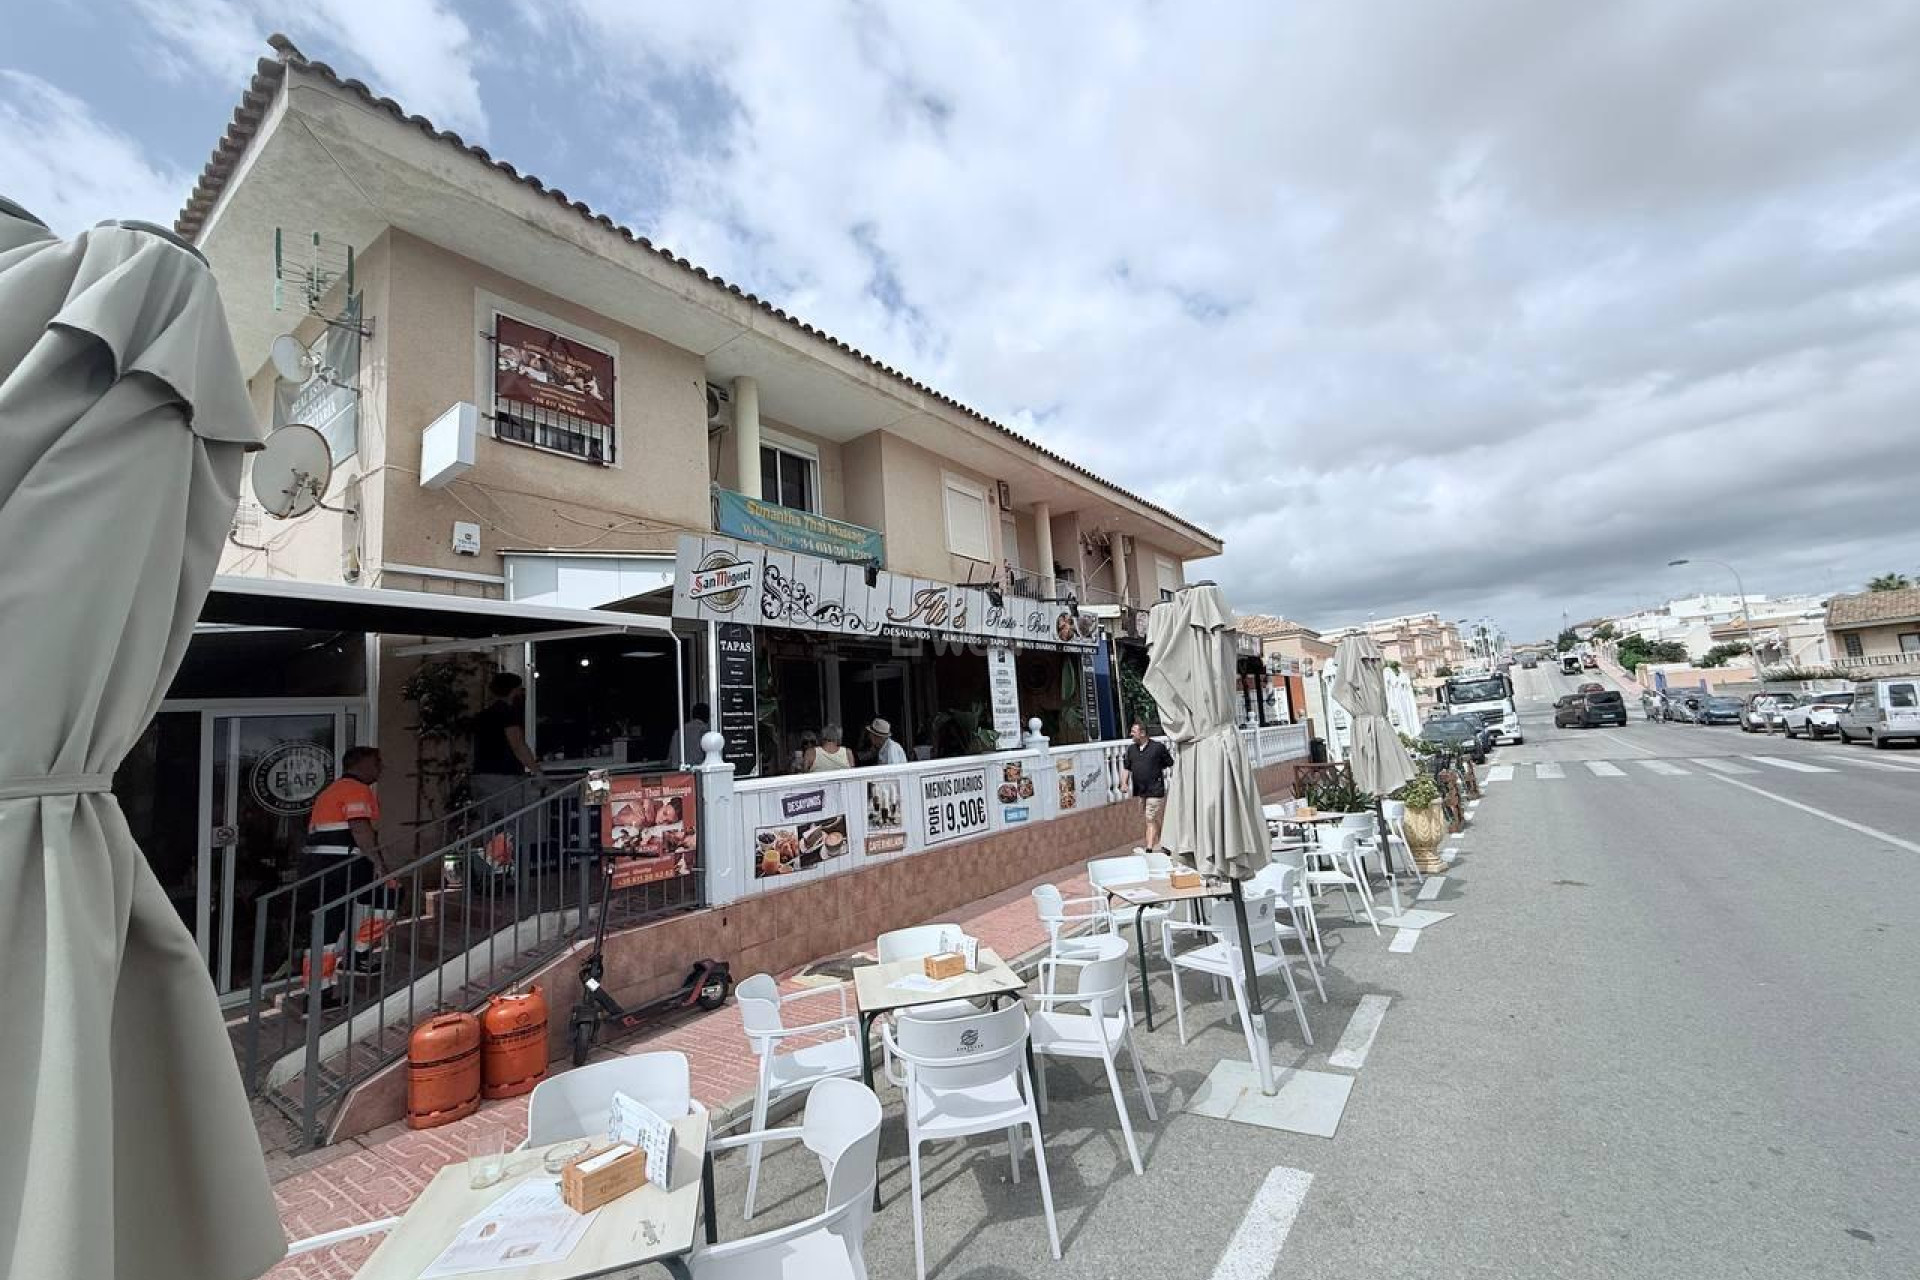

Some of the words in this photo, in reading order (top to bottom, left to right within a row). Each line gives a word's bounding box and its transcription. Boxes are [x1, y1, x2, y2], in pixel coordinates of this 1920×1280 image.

[1027, 611, 1050, 634] Bar
[720, 640, 752, 653] TAPAS
[883, 626, 931, 641] DESAYUNOS
[941, 633, 982, 646] ALMUERZOS
[925, 776, 951, 799] MENÚS
[953, 775, 983, 794] DIARIOS
[787, 795, 822, 813] DESAYUNOS
[946, 797, 986, 834] 9,90€
[929, 805, 940, 835] POR
